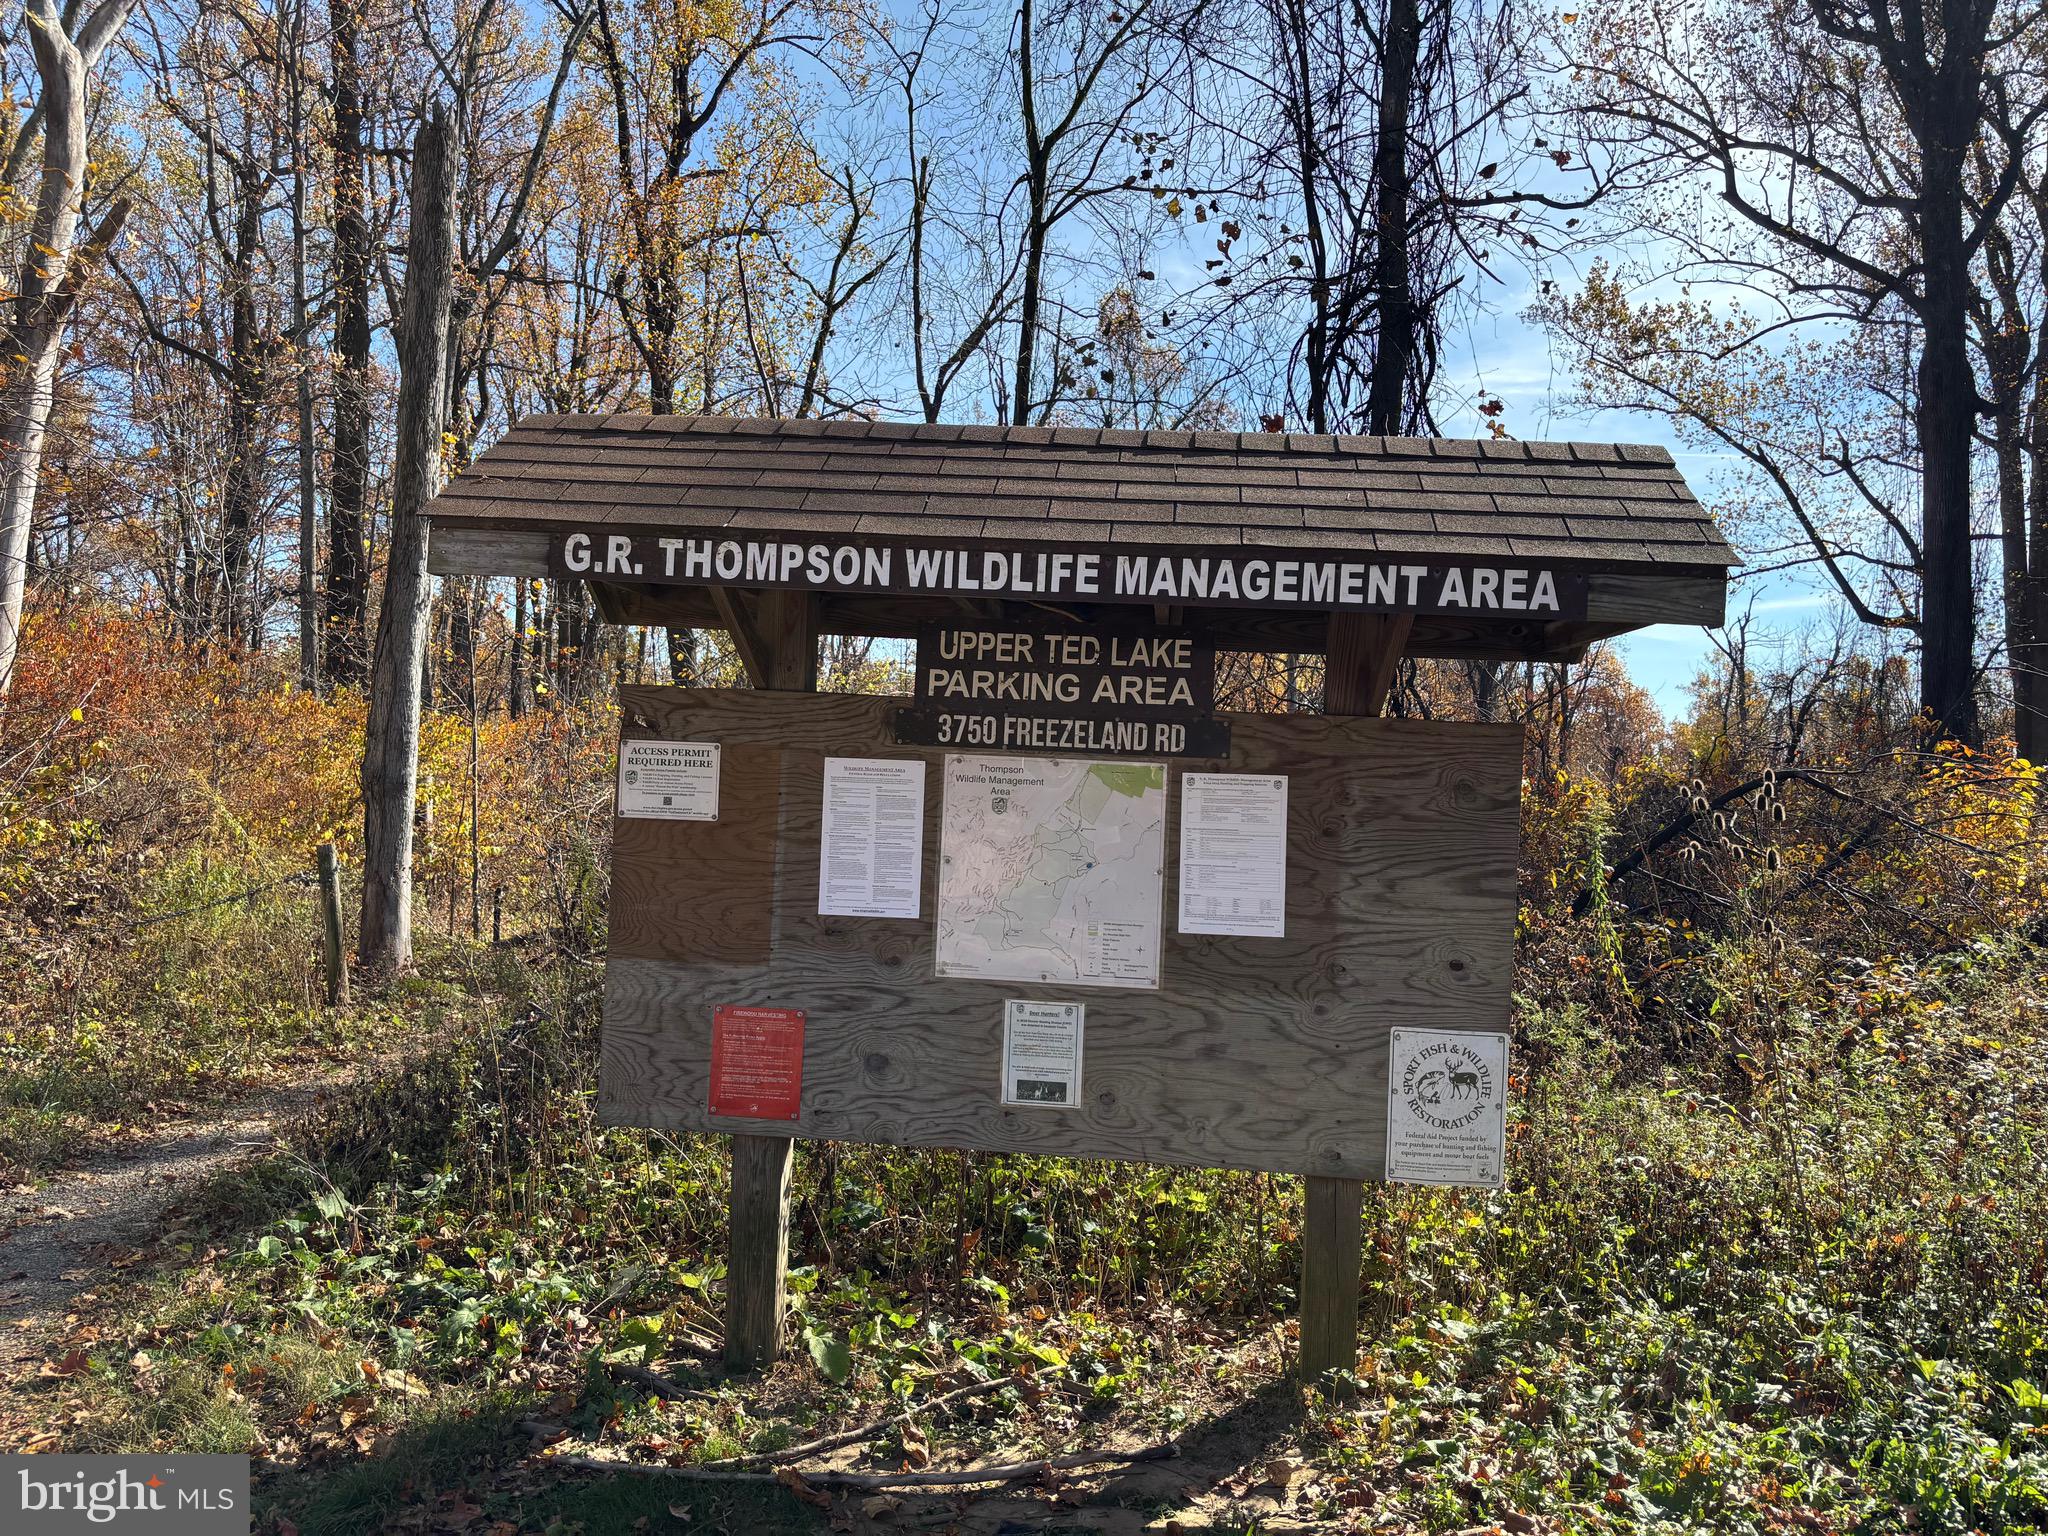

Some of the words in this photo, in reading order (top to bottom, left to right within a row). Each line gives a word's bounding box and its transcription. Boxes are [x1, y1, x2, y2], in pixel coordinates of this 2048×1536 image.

[564, 533, 643, 575] G.R.
[658, 537, 891, 587] THOMPSON
[905, 549, 1100, 594] WILDLIFE
[1114, 555, 1428, 606] MANAGEMENT
[1437, 567, 1560, 611] AREA
[939, 630, 1033, 663] UPPER
[1044, 634, 1100, 665] TED
[1111, 637, 1193, 669] LAKE
[928, 668, 1080, 702] PARKING
[1091, 674, 1195, 706] AREA
[937, 714, 997, 745] 3750
[1003, 717, 1148, 751] FREEZELAND
[1154, 723, 1186, 752] RD
[631, 747, 669, 756] ACCESS
[671, 748, 712, 758] PERMIT
[627, 757, 682, 767] REQUIRED
[684, 759, 714, 768] HERE
[979, 764, 1024, 774] Thompson
[955, 774, 986, 783] Wildlife
[988, 775, 1044, 786] Management
[990, 786, 1011, 795] Area
[1403, 1056, 1421, 1095] SPORT
[1419, 1043, 1447, 1060] FISH
[1450, 1044, 1460, 1054] &
[1461, 1047, 1492, 1099] WILDLIFE
[1407, 1098, 1486, 1129] RESTORATION
[1405, 1131, 1426, 1139] Federal
[1426, 1132, 1437, 1140] Aid
[1438, 1133, 1458, 1142] Project
[1459, 1134, 1478, 1142] funded
[1479, 1135, 1487, 1144] by
[1409, 1141, 1434, 1149] purchase
[1442, 1143, 1465, 1152] hunting
[1477, 1144, 1497, 1153] fishing
[1400, 1150, 1432, 1158] equipment
